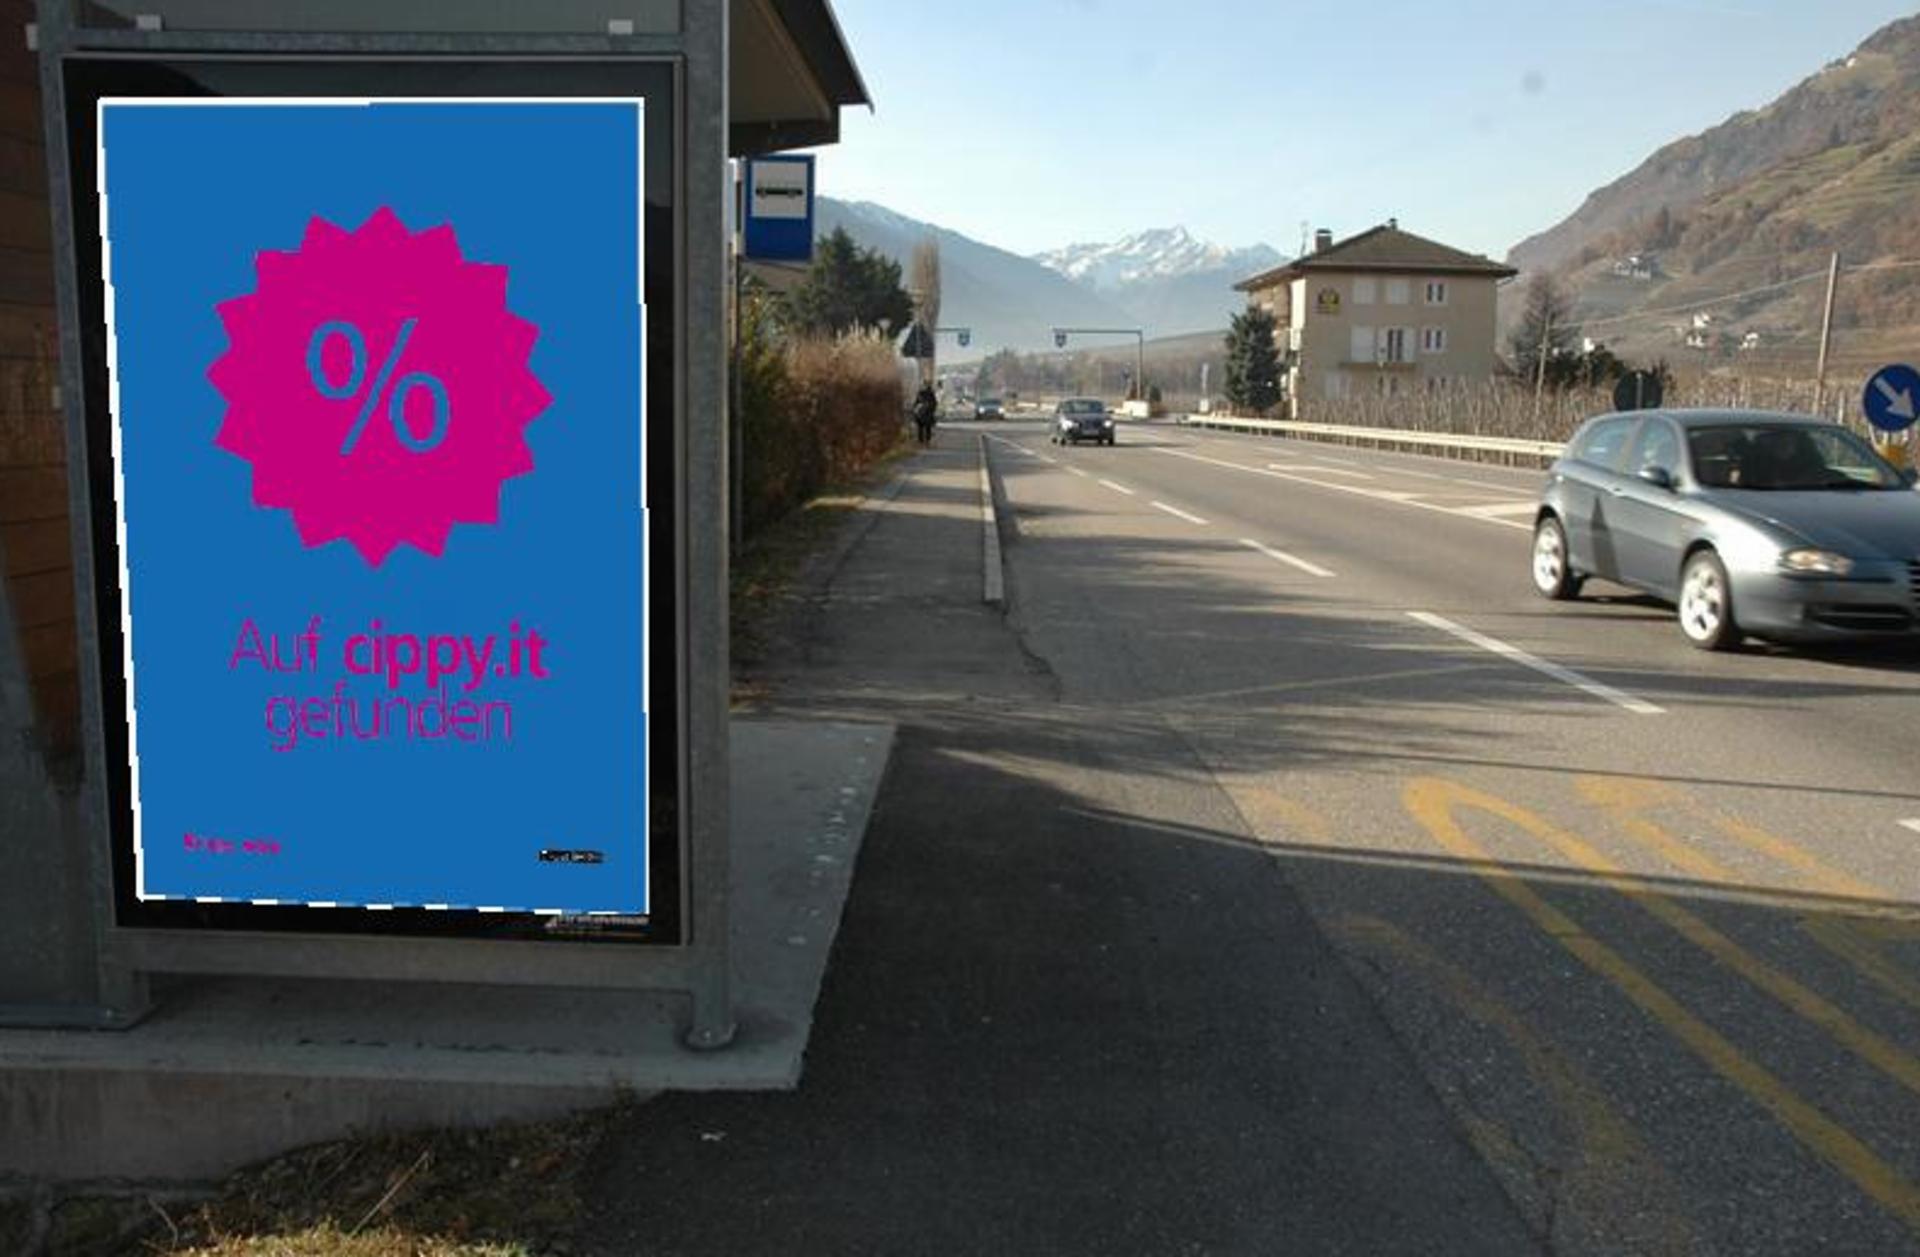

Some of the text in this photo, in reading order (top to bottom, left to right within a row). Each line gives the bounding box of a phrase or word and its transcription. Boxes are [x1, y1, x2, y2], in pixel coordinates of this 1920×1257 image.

[228, 615, 551, 691] Auf cippy.it
[264, 679, 513, 752] gefunden
